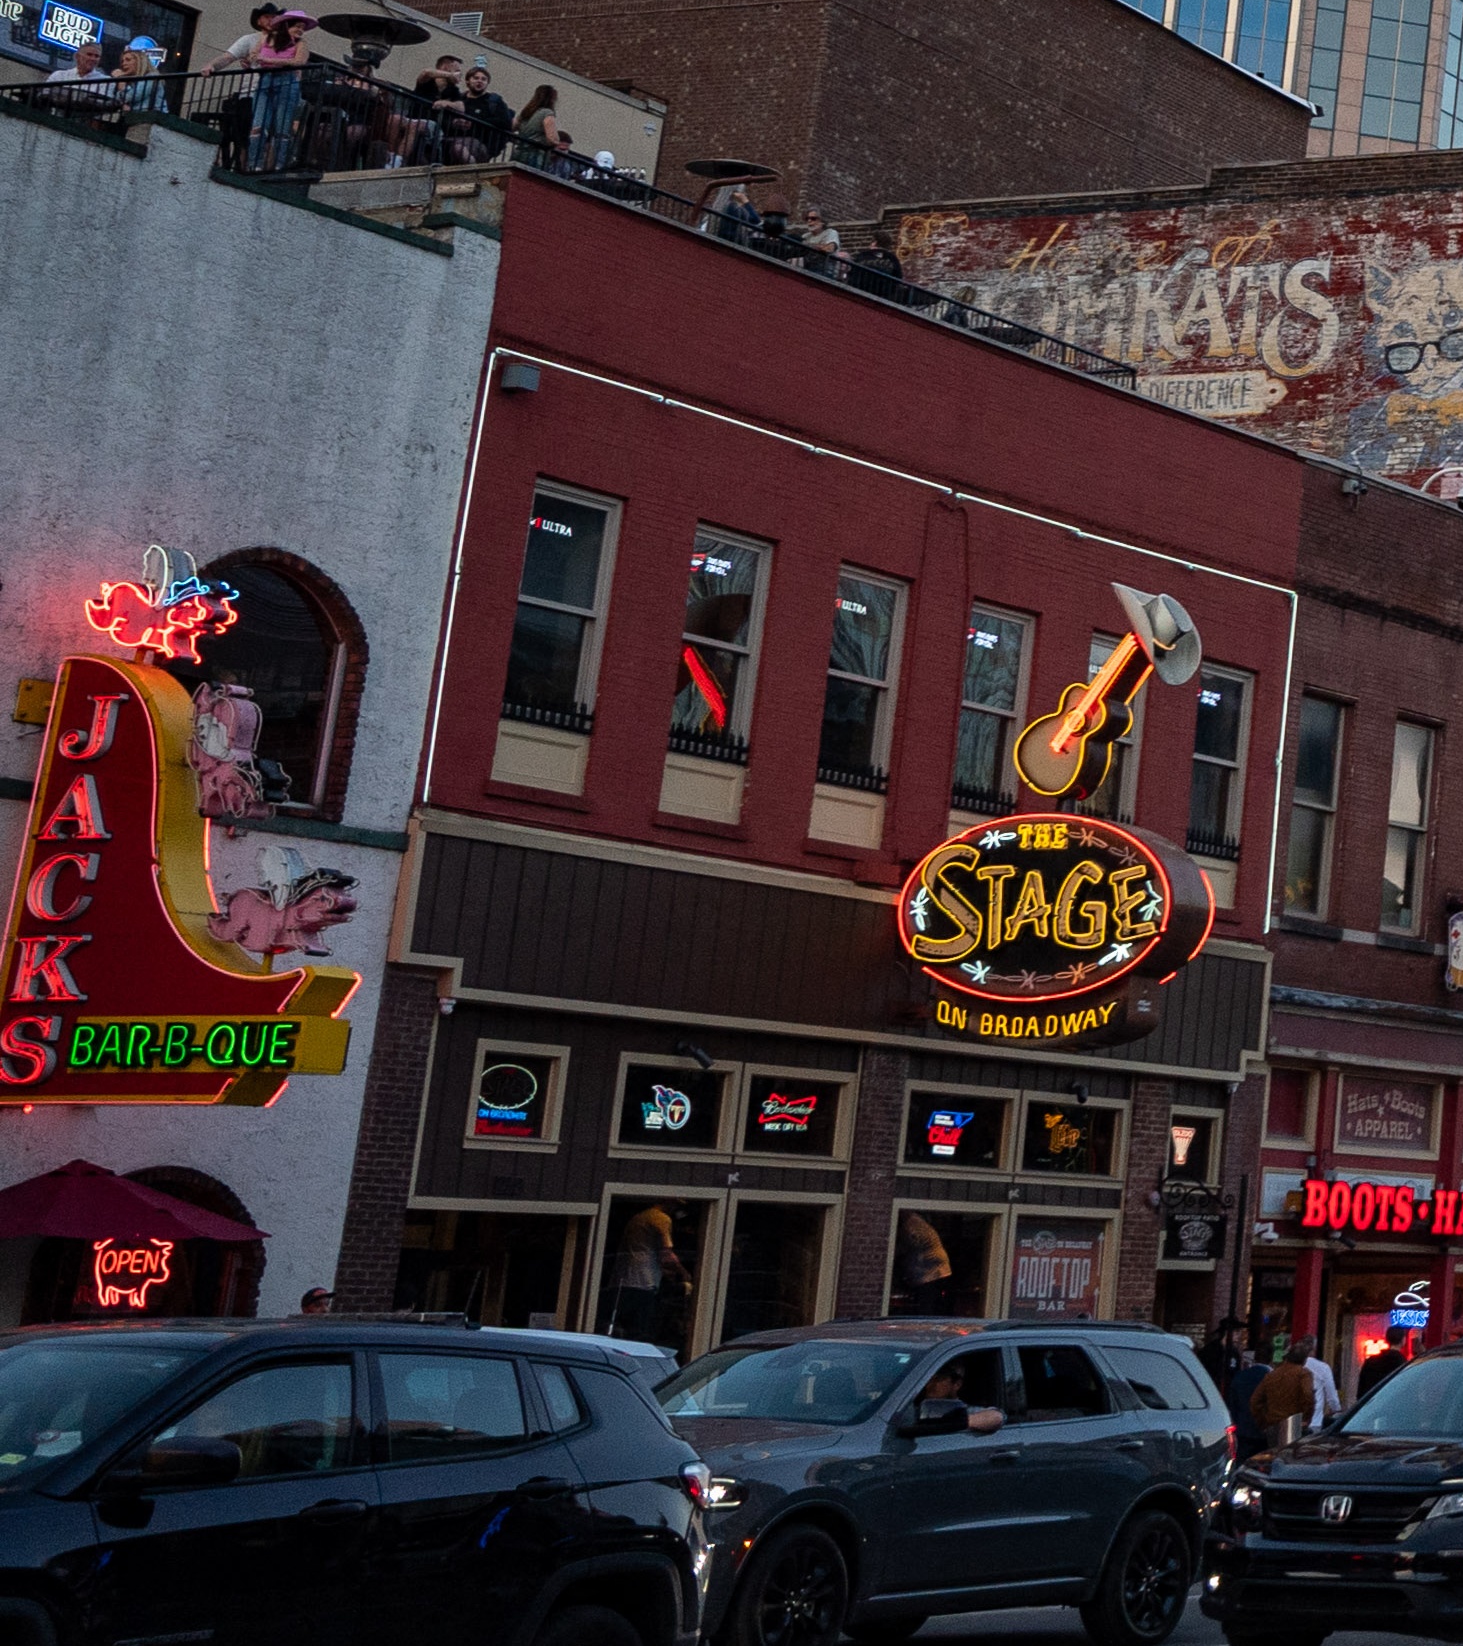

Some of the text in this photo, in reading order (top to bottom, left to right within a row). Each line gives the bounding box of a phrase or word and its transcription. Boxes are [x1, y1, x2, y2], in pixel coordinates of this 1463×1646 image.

[53, 6, 94, 34] BUD
[541, 519, 573, 538] ULTRA
[841, 599, 867, 616] ULTRA
[1017, 822, 1069, 849] THE
[0, 691, 131, 1086] JACKS
[911, 843, 1159, 963] STAGE
[936, 1000, 1118, 1038] ON BROADWAY
[68, 1020, 300, 1071] BAR-B-QUE
[1354, 1118, 1414, 1141] APPAREL
[1302, 1178, 1416, 1233] BOOTS
[100, 1245, 162, 1277] OPEN
[1015, 1256, 1092, 1299] ROOFTOP
[1036, 1301, 1066, 1312] BAR
